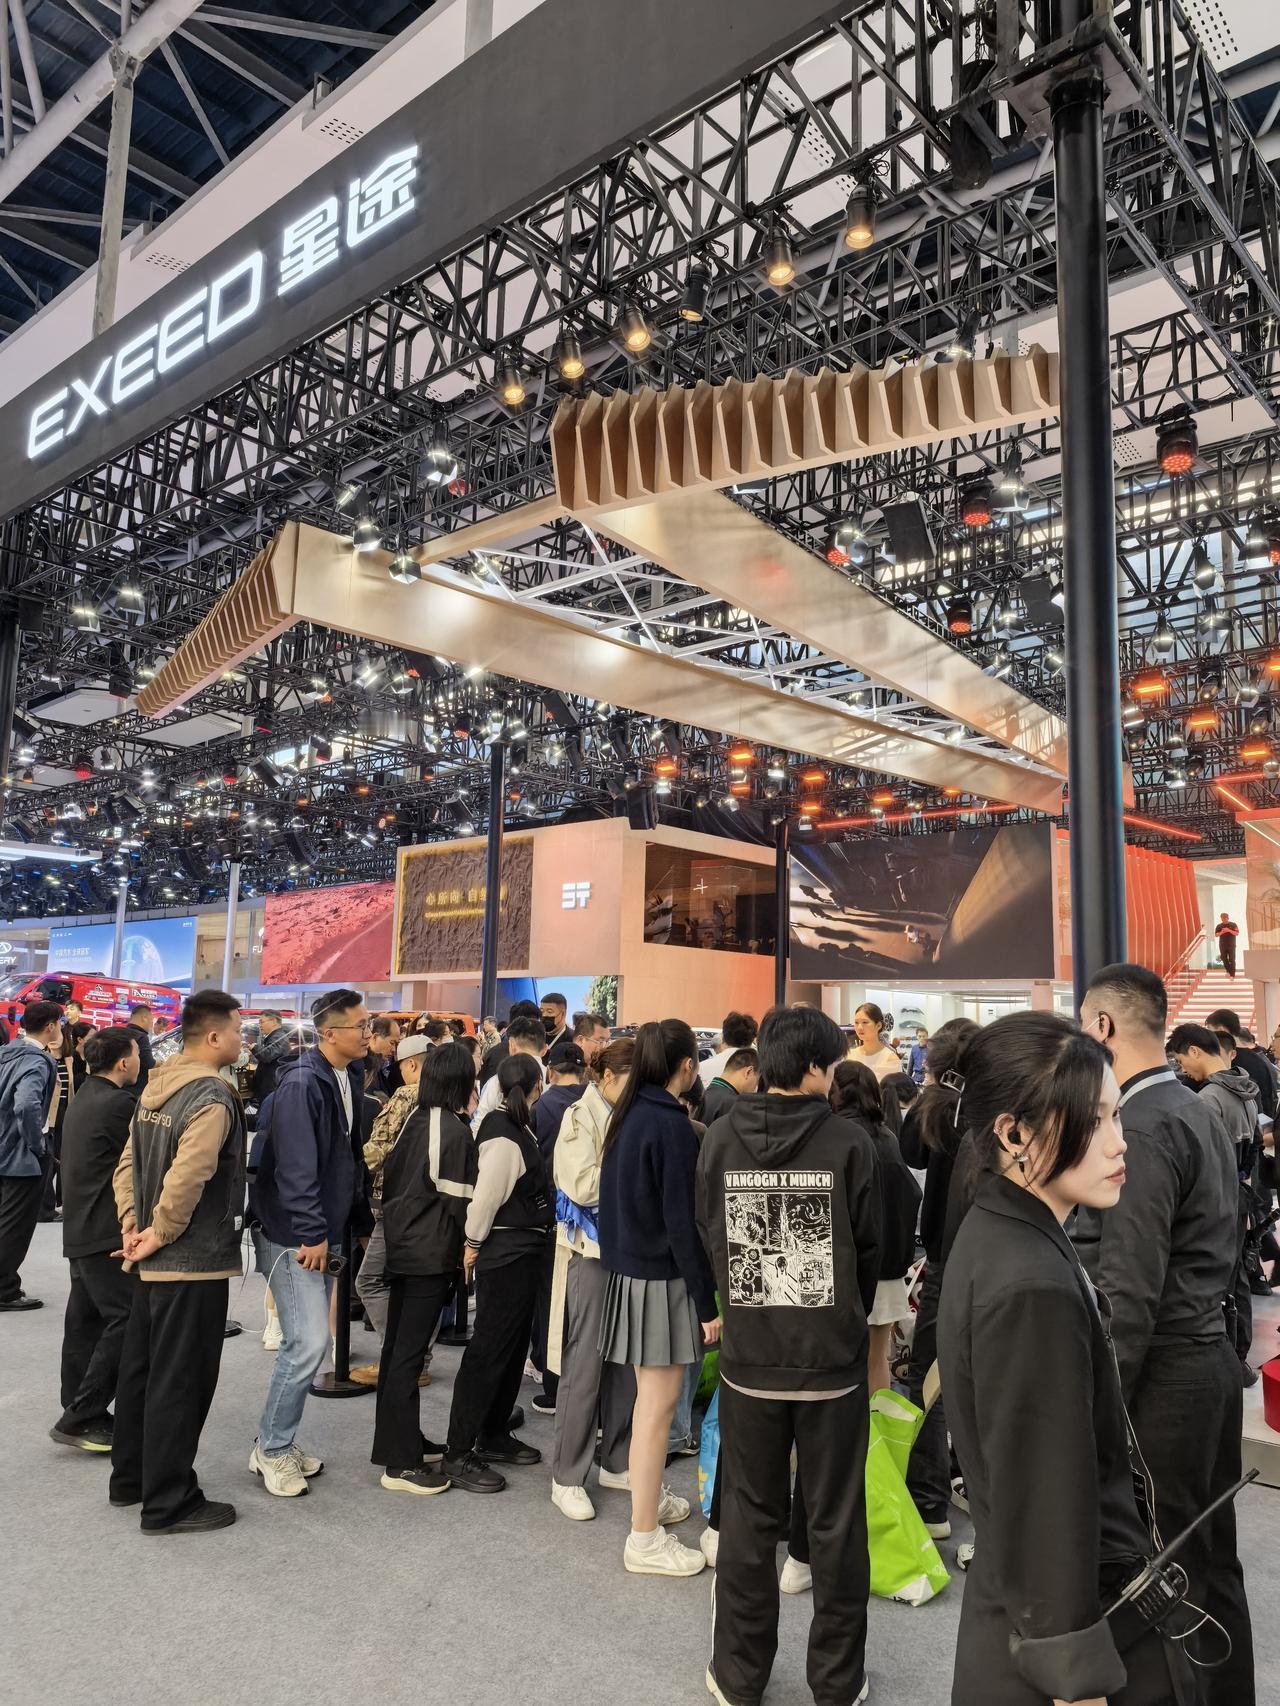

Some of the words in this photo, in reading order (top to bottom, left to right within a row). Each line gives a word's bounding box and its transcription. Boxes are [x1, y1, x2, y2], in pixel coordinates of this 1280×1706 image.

[27, 250, 264, 459] EXEED
[277, 144, 418, 297] 星途
[725, 1173, 778, 1188] VANGOGH
[780, 1173, 788, 1187] X
[789, 1173, 831, 1188] MUNCH
